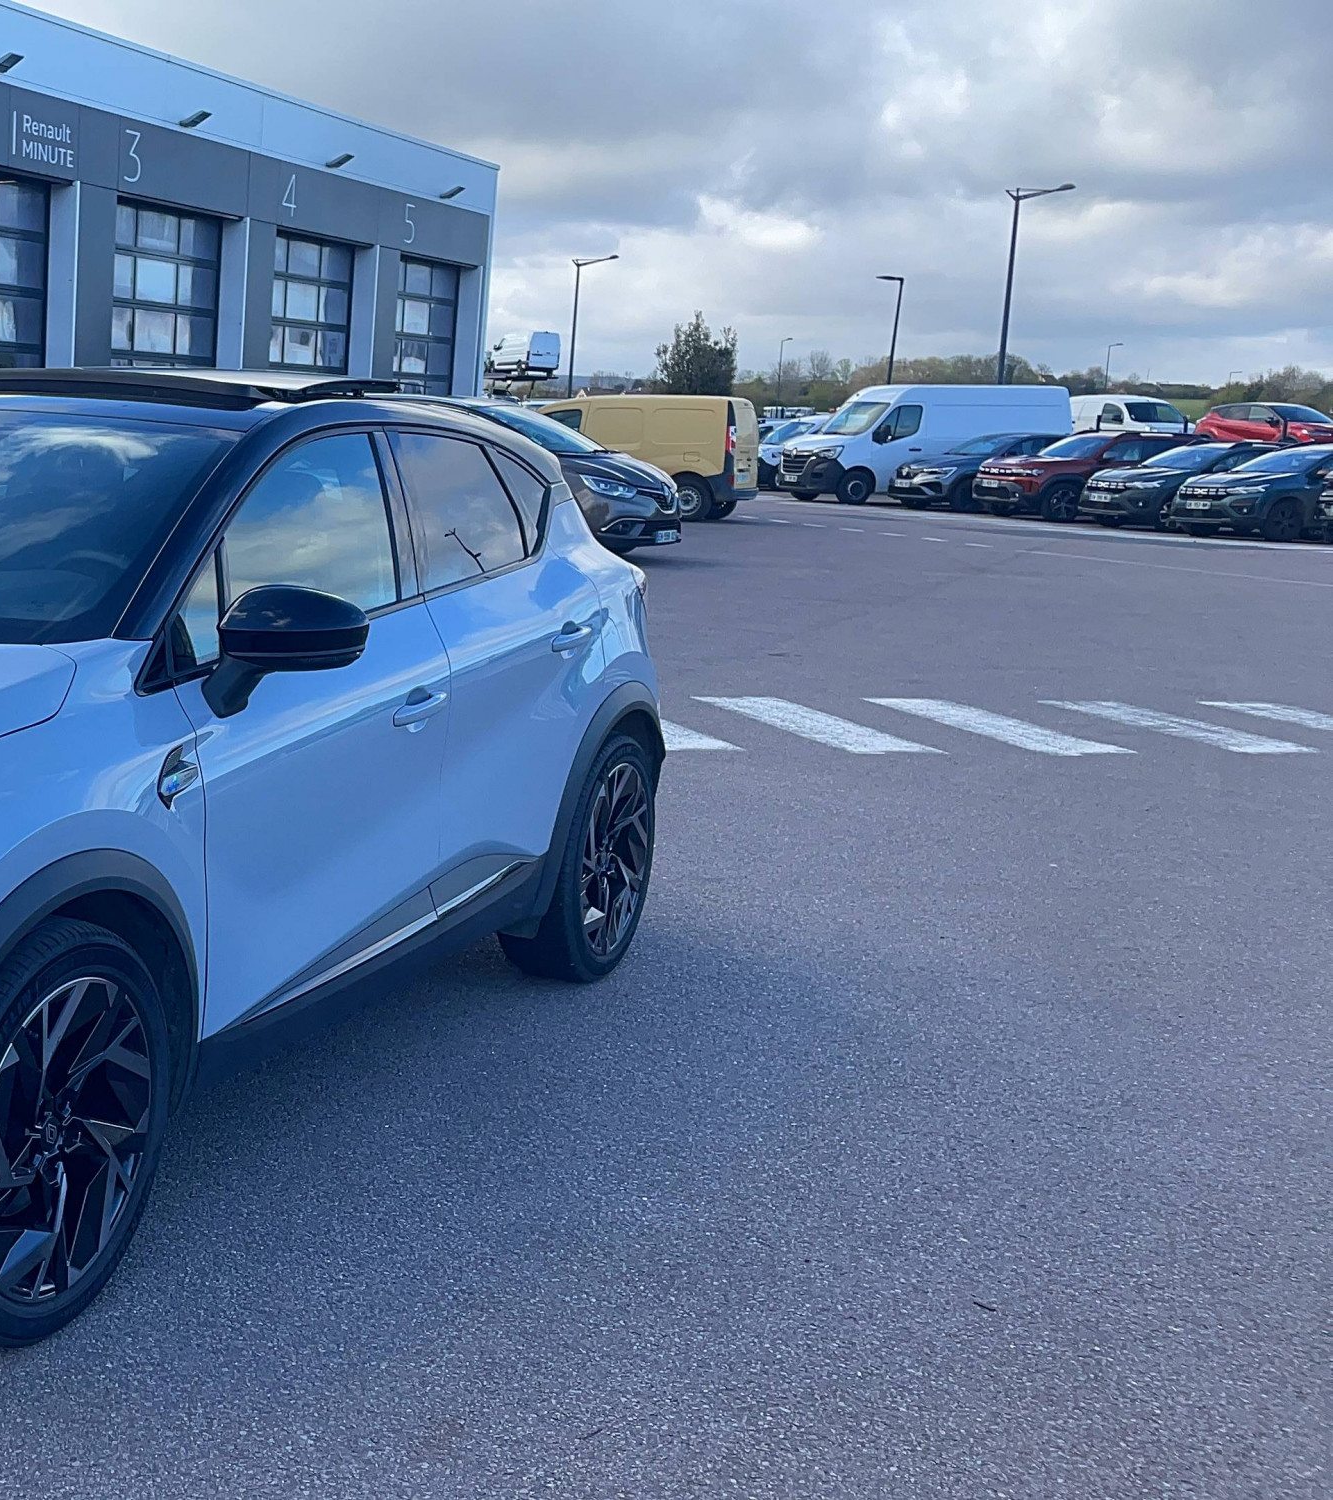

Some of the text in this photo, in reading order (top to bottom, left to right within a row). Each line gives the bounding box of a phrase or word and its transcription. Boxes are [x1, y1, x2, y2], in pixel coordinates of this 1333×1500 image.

[22, 114, 71, 143] Renault
[22, 139, 74, 168] MINUTE
[123, 129, 142, 183] 3
[282, 174, 297, 217] 4
[403, 203, 416, 244] 5
